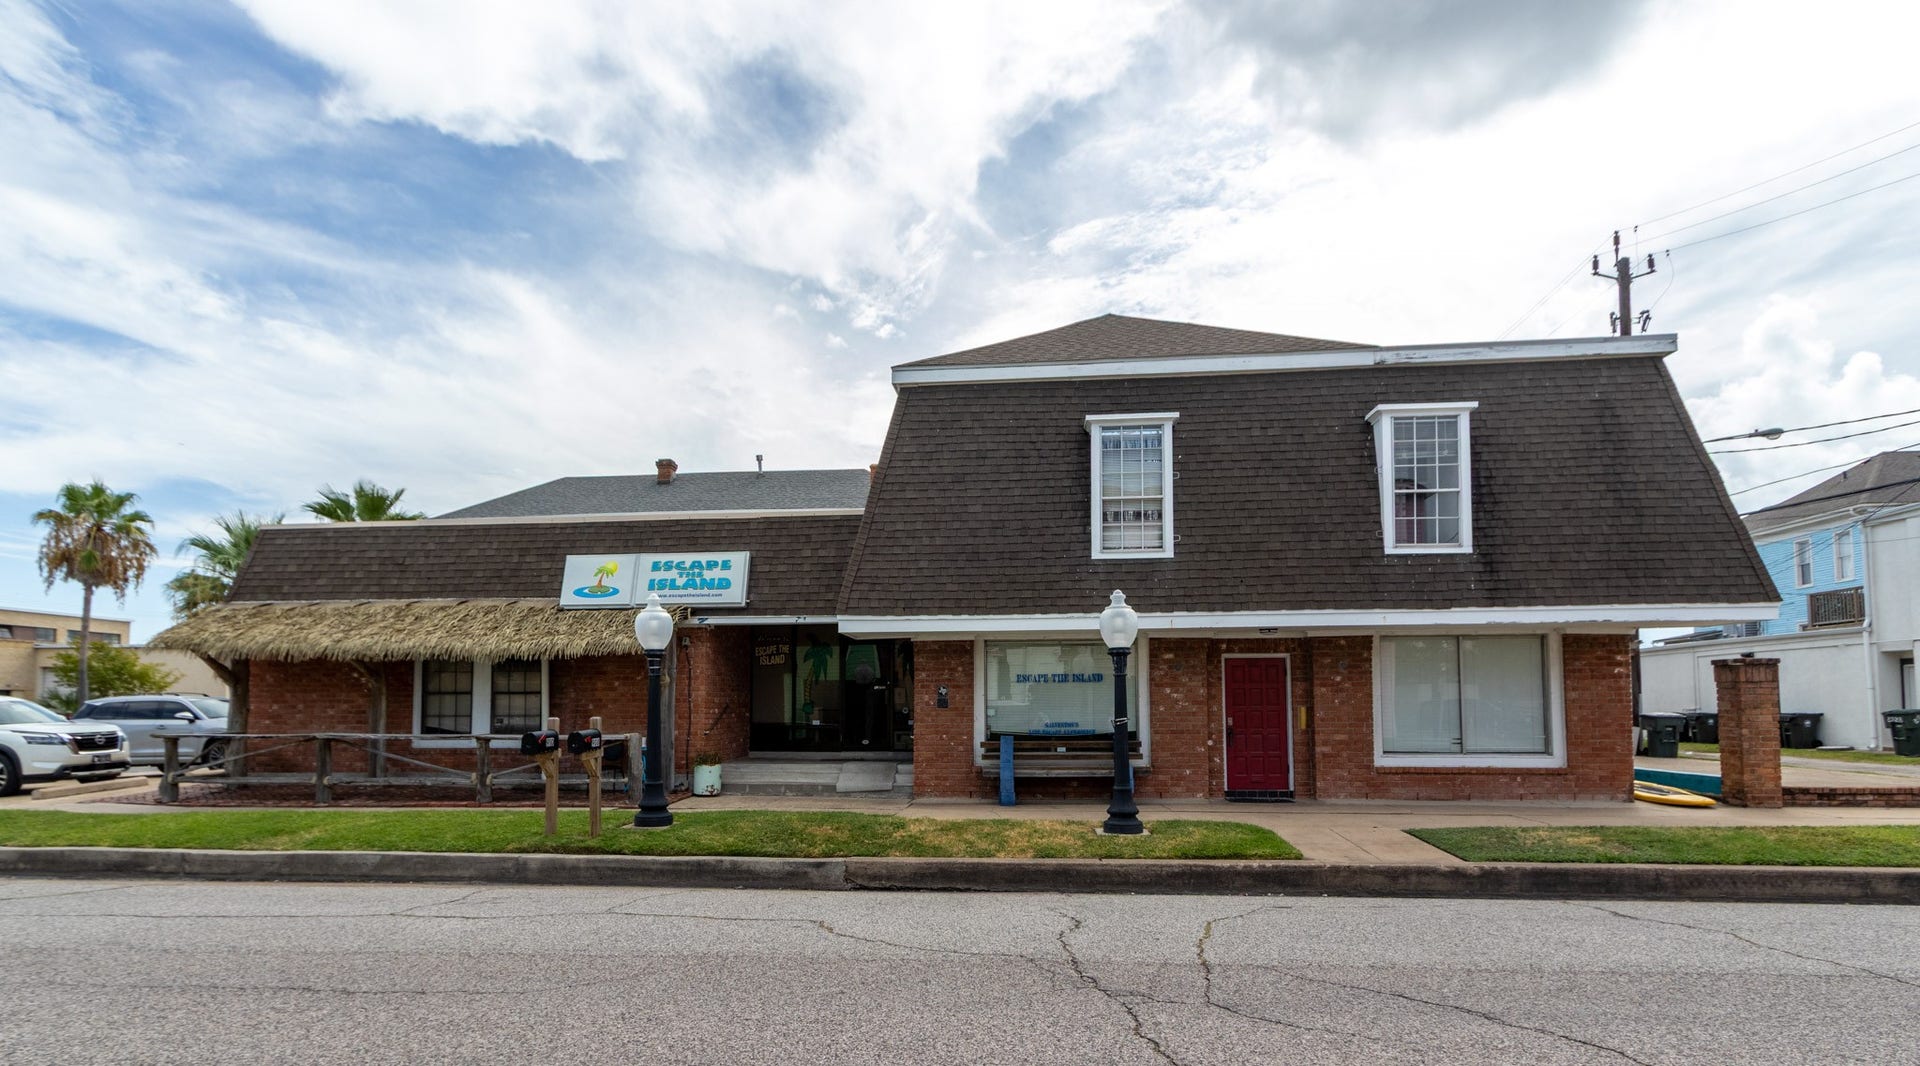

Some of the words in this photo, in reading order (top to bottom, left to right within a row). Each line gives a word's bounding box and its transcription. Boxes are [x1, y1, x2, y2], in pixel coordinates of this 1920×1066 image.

[651, 559, 732, 572] ESCAPE
[647, 577, 732, 591] ISLAND
[755, 645, 777, 656] ESCAPE
[779, 644, 790, 654] THE
[759, 654, 785, 666] ISLAND
[1016, 673, 1049, 683] ESCAPE
[1051, 673, 1070, 683] THE
[1072, 673, 1104, 683] ISLAND
